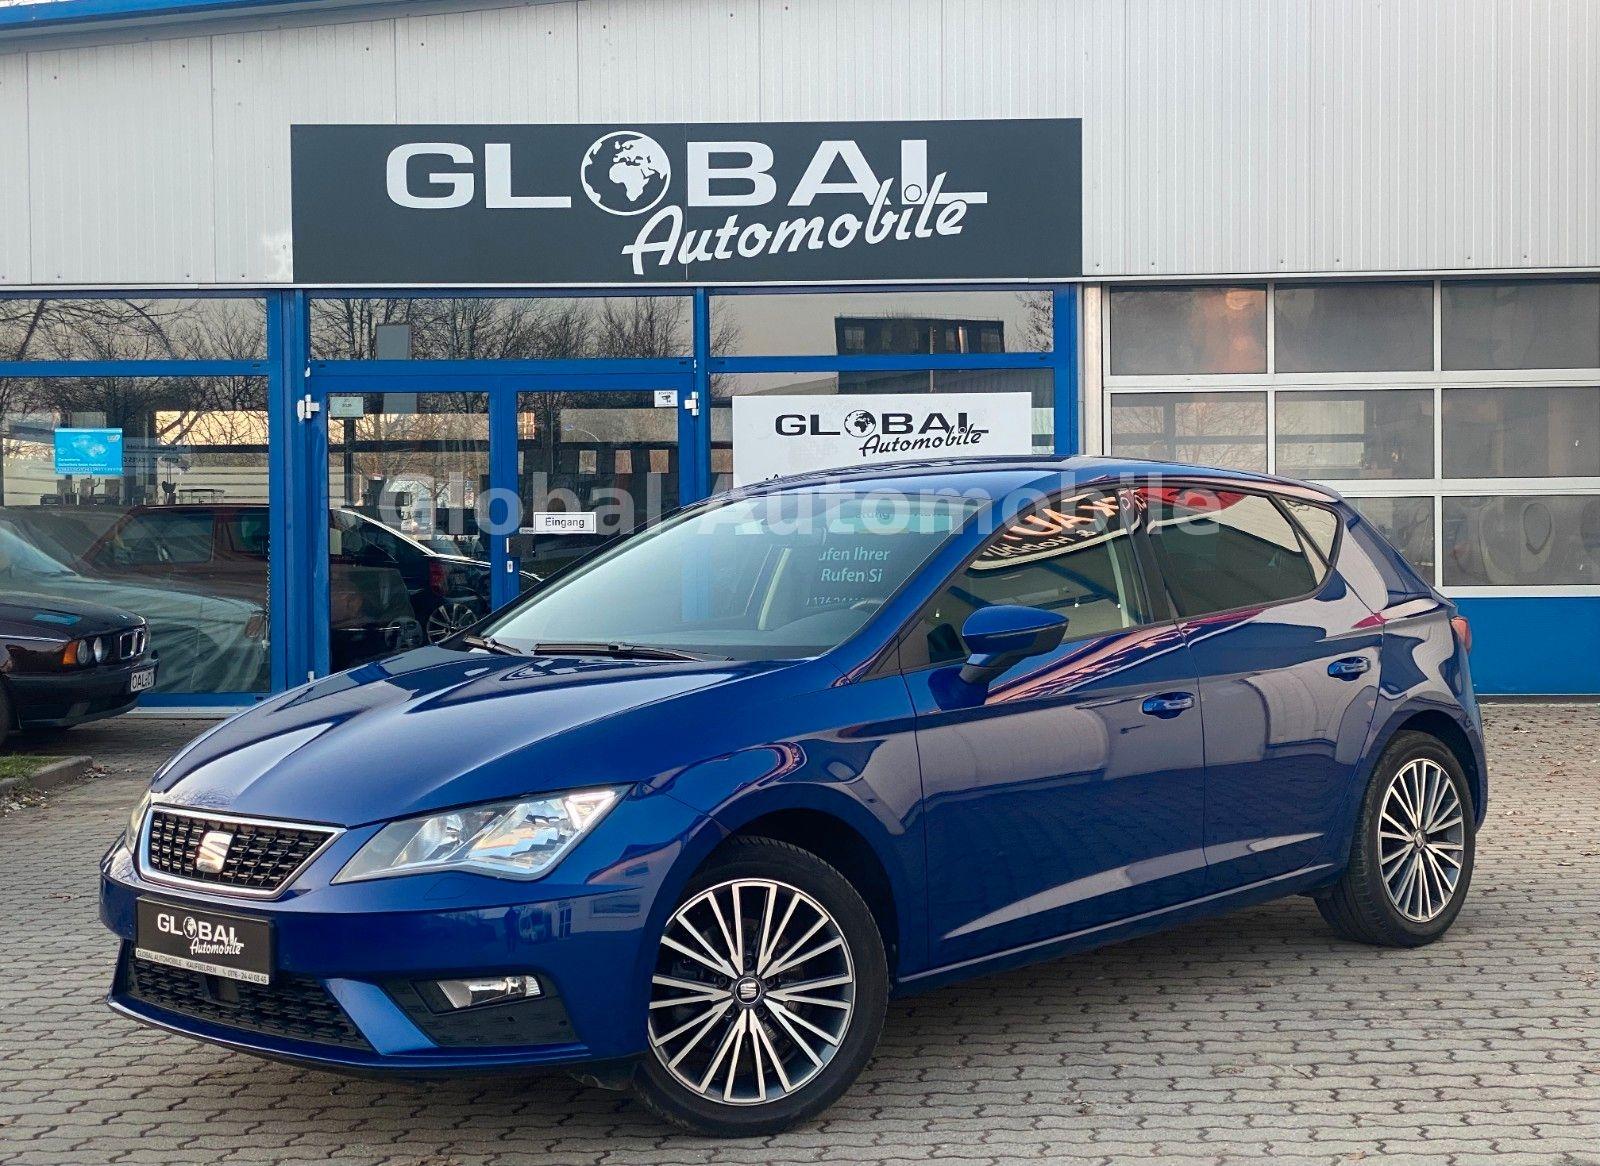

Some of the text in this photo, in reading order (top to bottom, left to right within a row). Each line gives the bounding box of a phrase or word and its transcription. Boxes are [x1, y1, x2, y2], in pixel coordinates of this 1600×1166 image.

[386, 131, 988, 216] GLOBAL
[622, 172, 969, 276] Automobile
[775, 409, 989, 438] GLOBAL
[859, 423, 983, 457] Automobile
[545, 516, 585, 529] Eingang
[853, 546, 891, 561] Ihrer
[821, 568, 865, 583] Rufen
[157, 913, 244, 947] GLOBAL
[190, 937, 242, 955] Automobile
